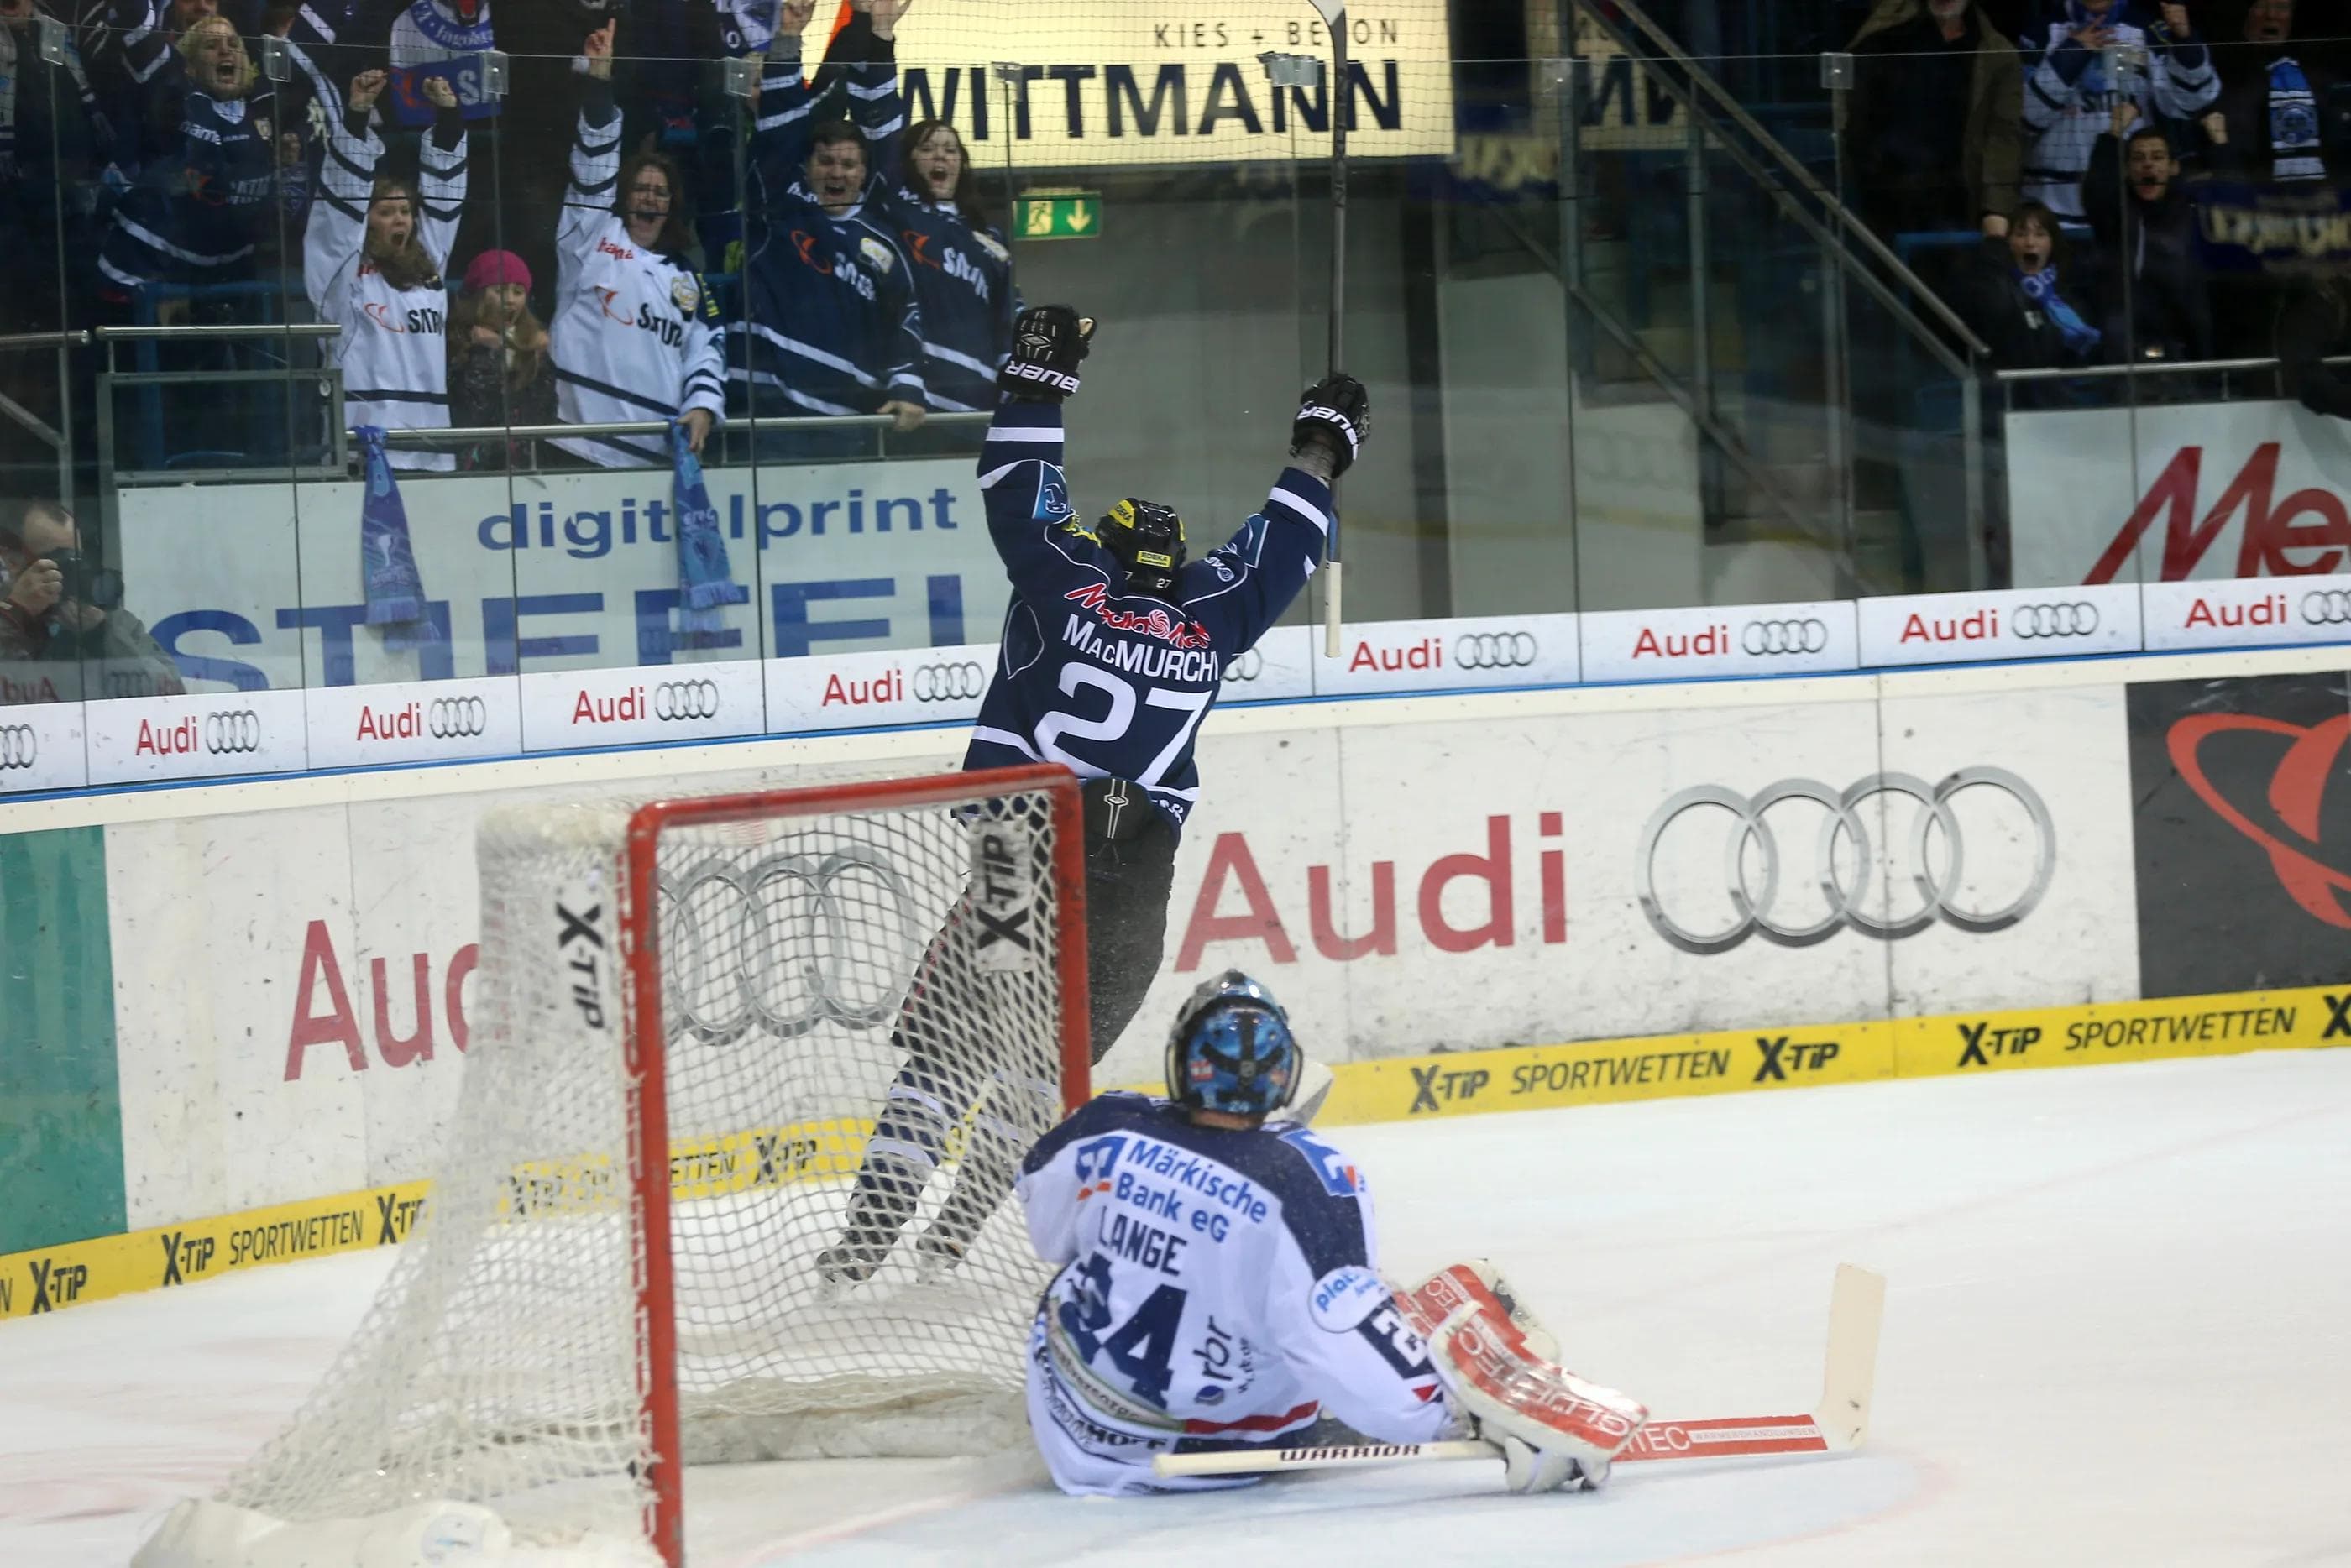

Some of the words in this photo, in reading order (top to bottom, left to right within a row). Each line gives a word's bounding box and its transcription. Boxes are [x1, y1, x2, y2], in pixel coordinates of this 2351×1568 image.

[1154, 23, 1228, 47] KIES
[1287, 18, 1397, 46] BEON
[903, 60, 1402, 141] WITTMANN
[1156, 578, 1172, 588] 27
[1902, 611, 1998, 644] Audi
[2186, 597, 2286, 628] Audi
[1350, 639, 1441, 672] Audi
[1633, 628, 1728, 657] Audi
[824, 672, 902, 704] Audi
[358, 705, 421, 740] Audi
[573, 689, 645, 723] Audi
[138, 720, 196, 754] Audi
[1034, 661, 1213, 787] 27
[1176, 811, 1566, 972] Audi
[2063, 1006, 2297, 1051] SPORTWETTEN
[1511, 1049, 1731, 1095] SPORTWETTEN
[1127, 1140, 1267, 1223] Märkische
[1116, 1172, 1183, 1222] Bank
[1191, 1209, 1231, 1243] eG
[228, 1210, 364, 1265] SPORTWETTEN
[1098, 1205, 1187, 1277] LANGE
[1280, 1444, 1420, 1462] WARRIOR
